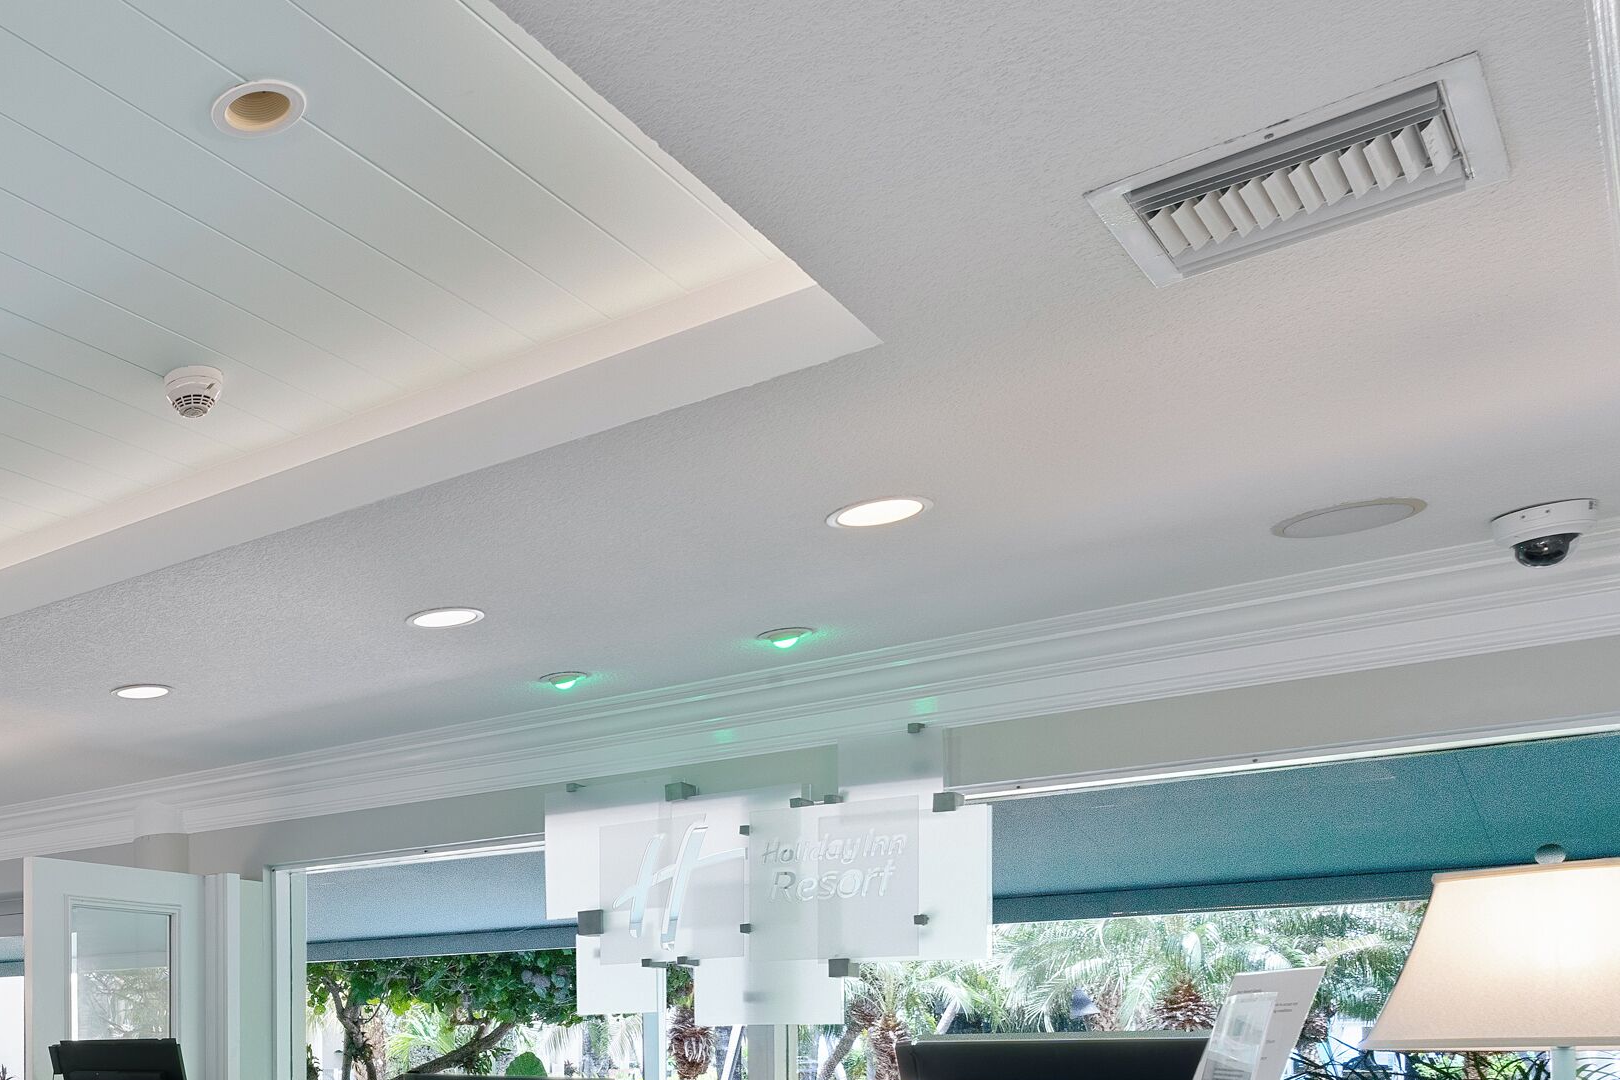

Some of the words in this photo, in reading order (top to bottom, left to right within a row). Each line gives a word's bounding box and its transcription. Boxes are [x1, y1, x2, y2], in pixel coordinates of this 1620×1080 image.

[762, 833, 862, 865] Holiday
[862, 828, 907, 858] Inn
[770, 859, 896, 902] Resort
